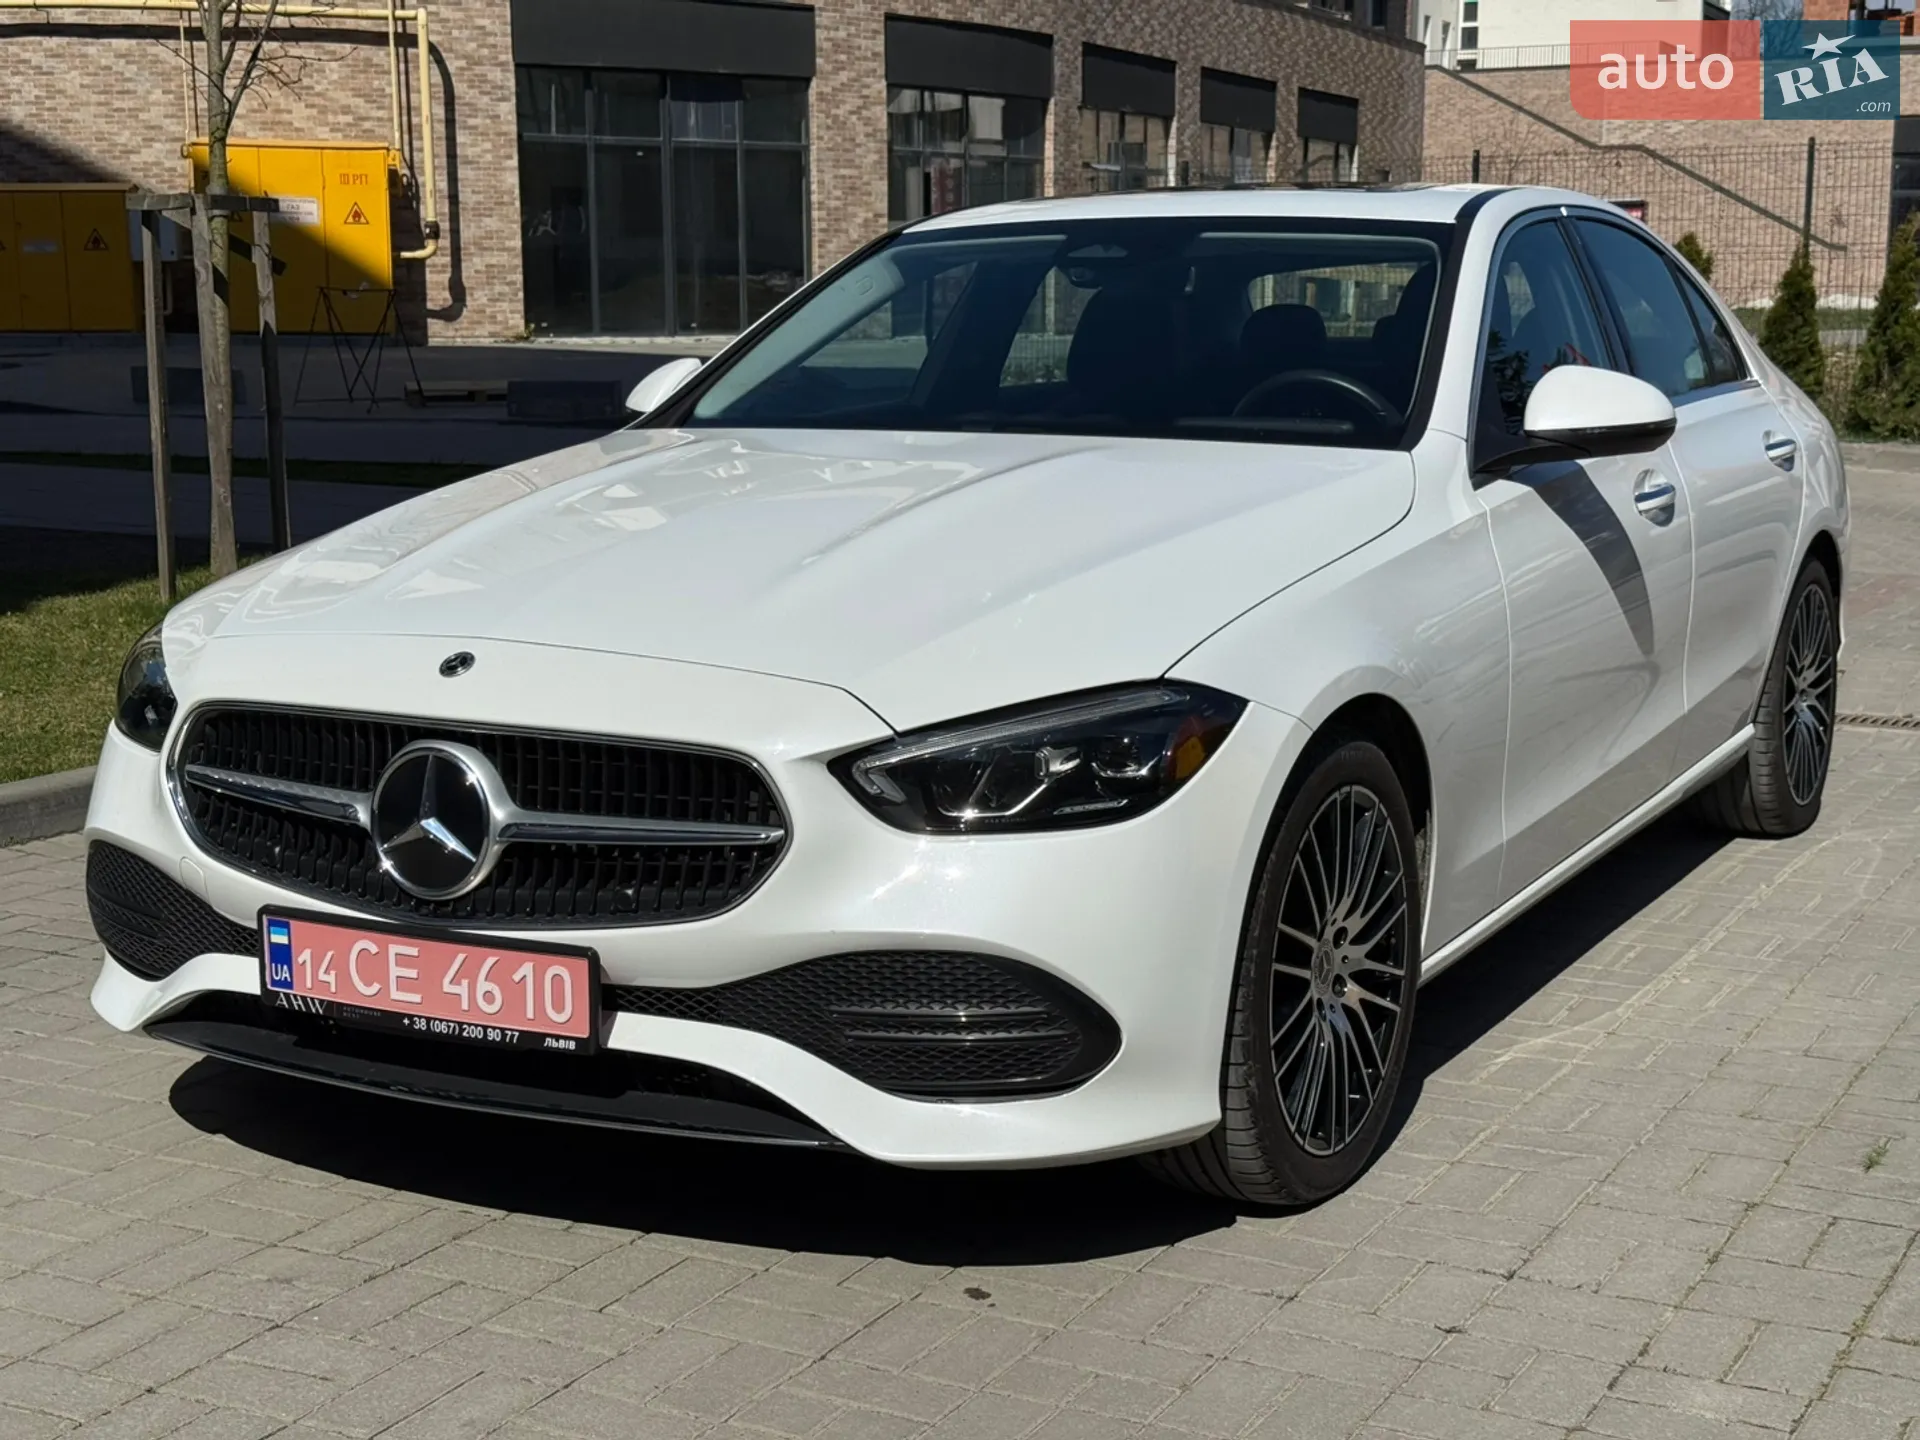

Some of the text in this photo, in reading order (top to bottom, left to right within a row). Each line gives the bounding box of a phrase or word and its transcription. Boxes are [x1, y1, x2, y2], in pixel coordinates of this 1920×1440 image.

[271, 963, 291, 982] UA
[297, 939, 573, 1023] 14 CE 4610
[275, 992, 327, 1015] AHW
[430, 1019, 459, 1035] (067)
[462, 1024, 484, 1039] 200
[487, 1028, 502, 1041] 90
[504, 1030, 519, 1044] 77
